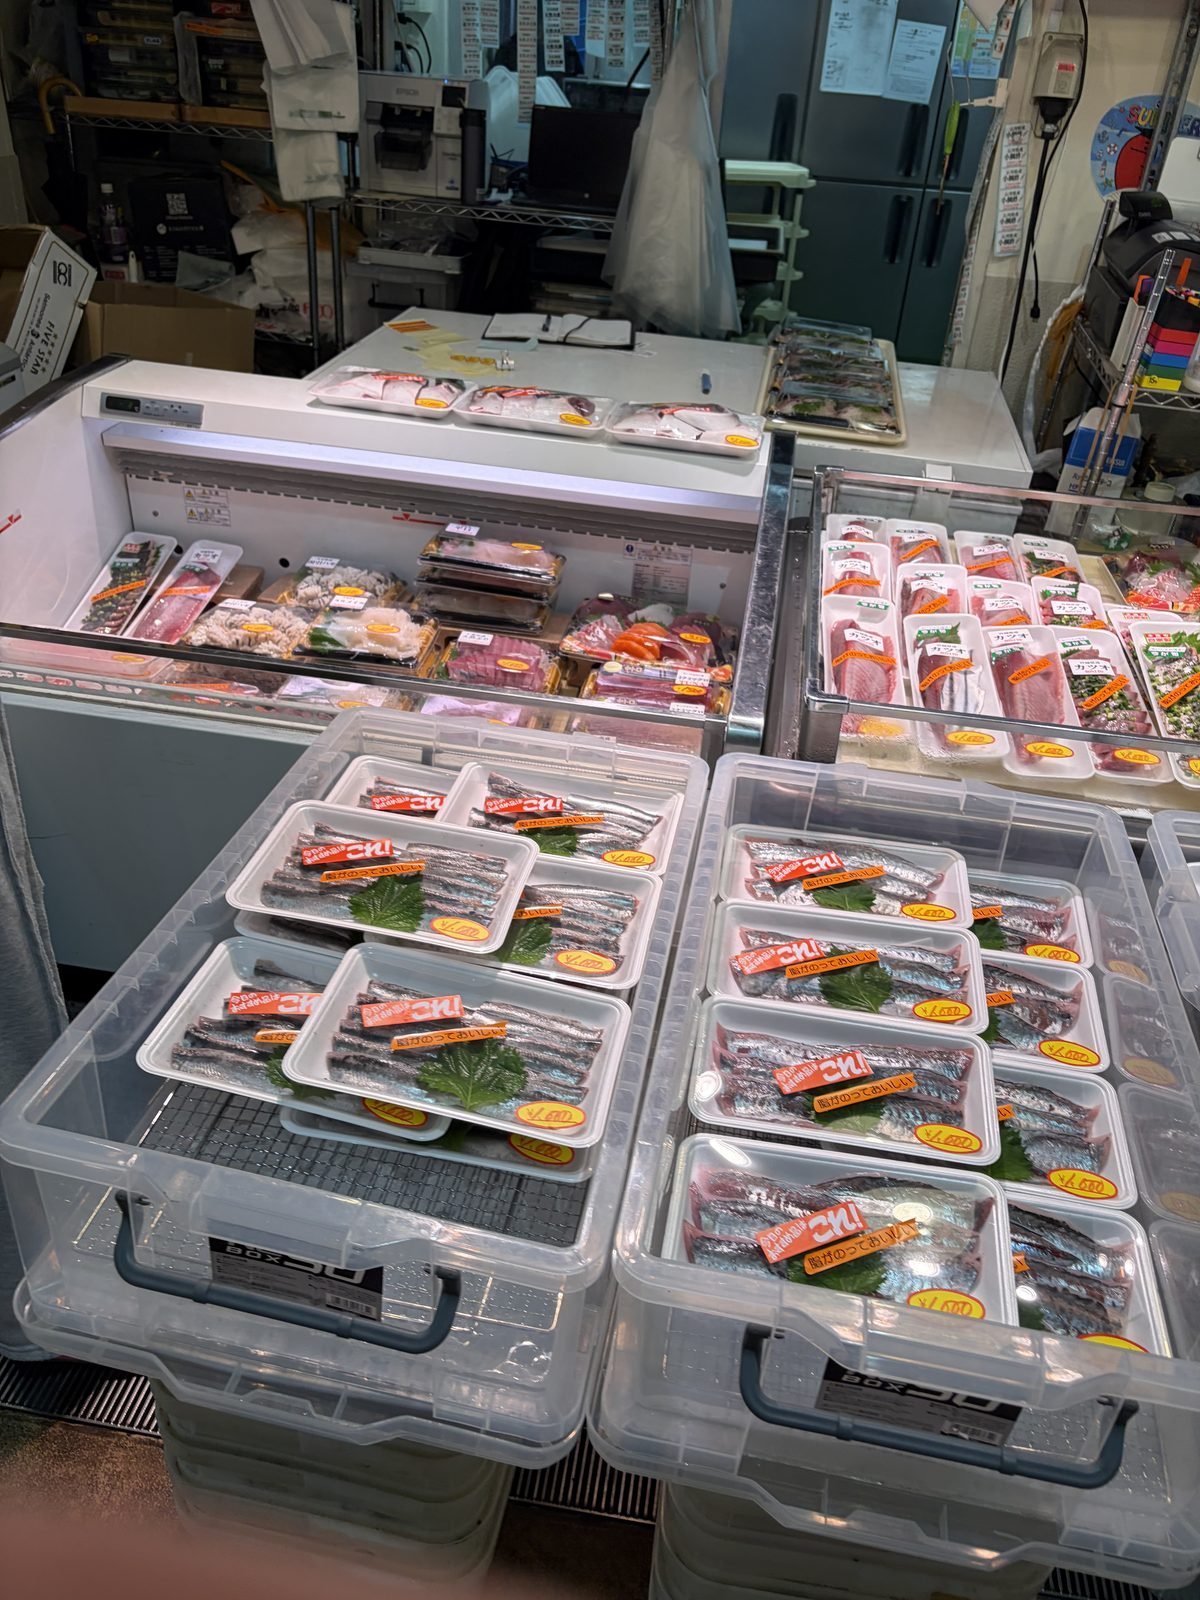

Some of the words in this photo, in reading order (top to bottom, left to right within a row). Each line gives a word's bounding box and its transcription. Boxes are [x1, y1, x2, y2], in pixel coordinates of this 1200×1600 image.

[41, 320, 55, 347] FIVE
[30, 347, 46, 376] STAR
[523, 798, 562, 812] これ!
[346, 839, 391, 859] これ!
[801, 853, 841, 873] これ!
[777, 940, 819, 964] これ!
[411, 996, 461, 1020] これ!
[818, 1053, 868, 1082] これ!
[816, 1075, 914, 1109] 脂がのっておいしい
[807, 1203, 864, 1243] これ!
[807, 1222, 920, 1270] 脂がのっておいしい
